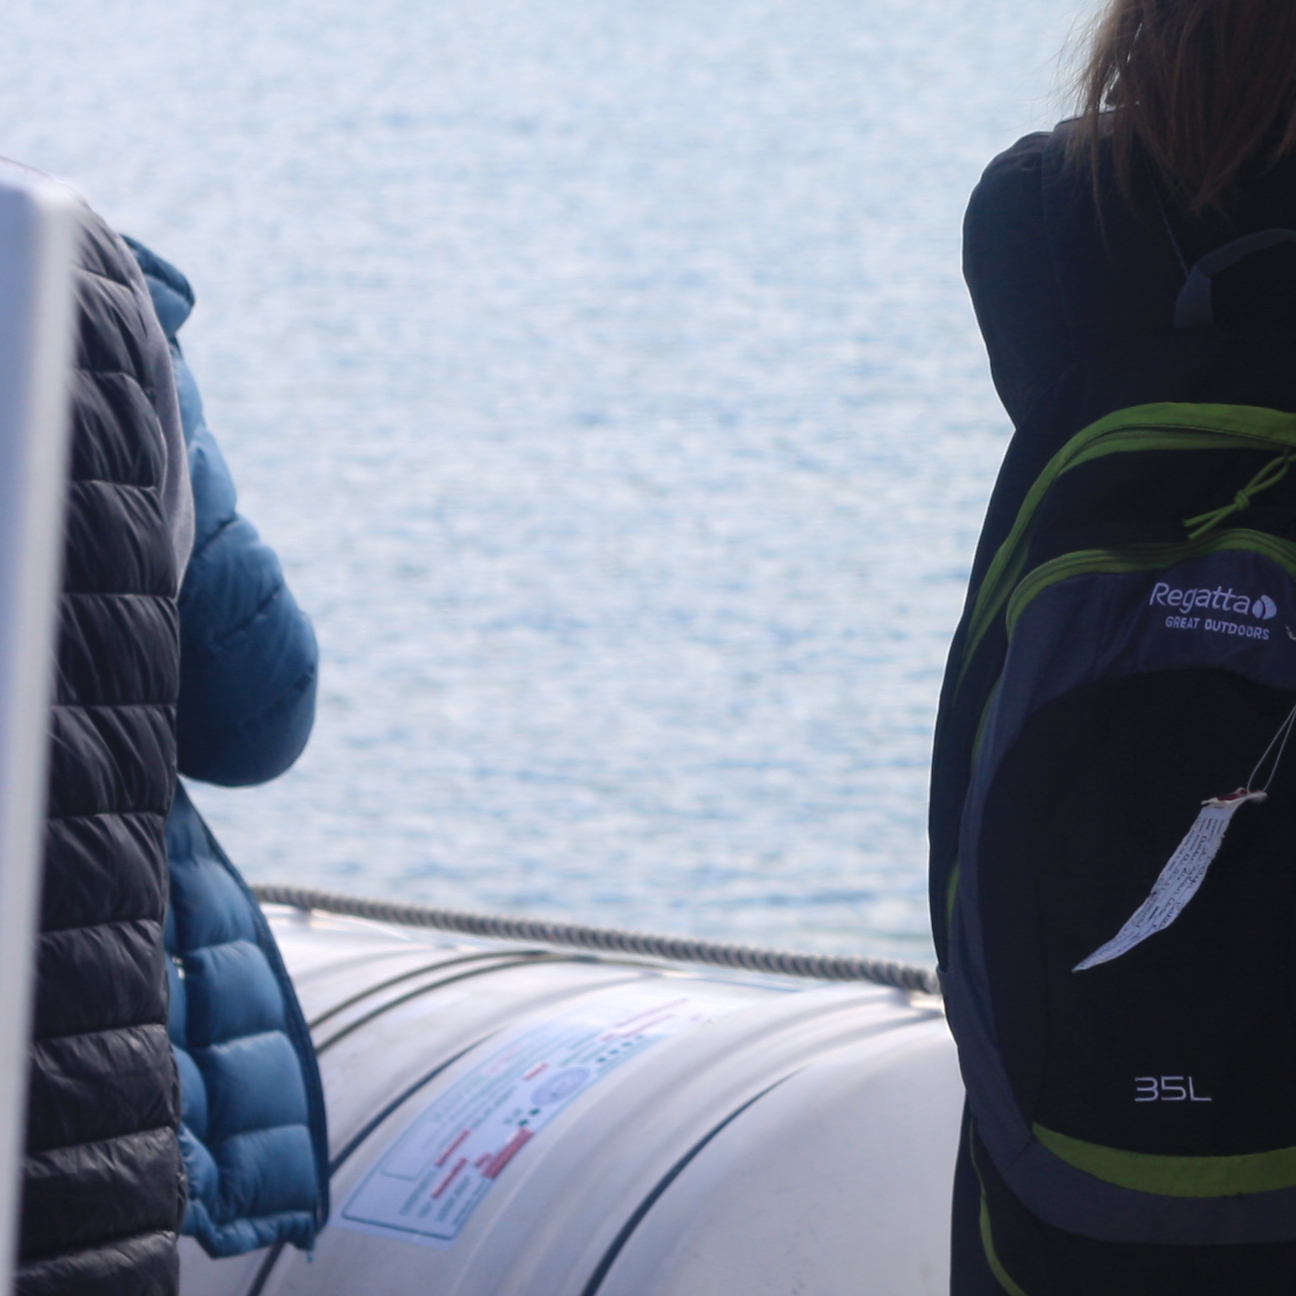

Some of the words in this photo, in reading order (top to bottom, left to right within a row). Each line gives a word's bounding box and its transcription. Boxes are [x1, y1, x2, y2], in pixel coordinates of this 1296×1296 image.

[1149, 582, 1250, 615] Regatta
[1165, 616, 1200, 629] GREAT
[1204, 619, 1270, 640] OUTDOORS
[1134, 1075, 1213, 1103] 35L
